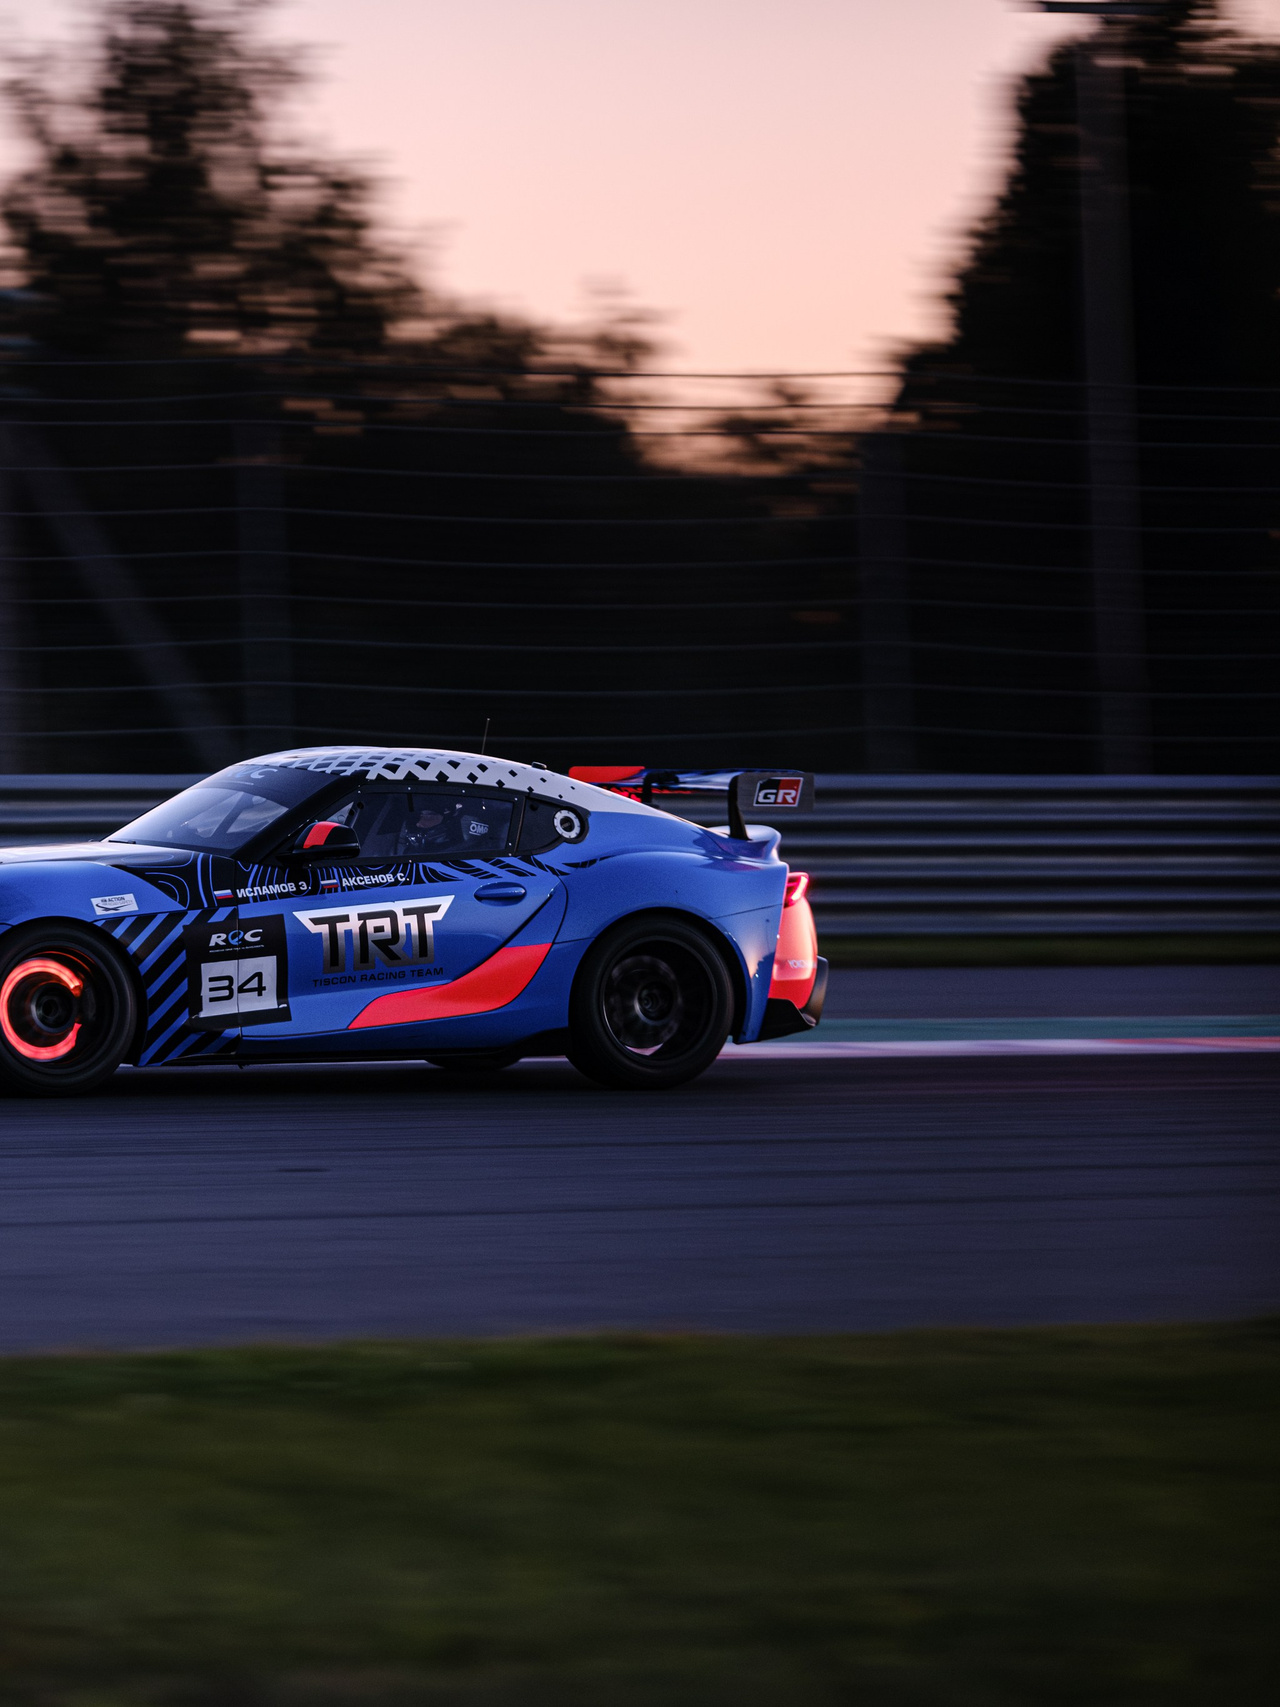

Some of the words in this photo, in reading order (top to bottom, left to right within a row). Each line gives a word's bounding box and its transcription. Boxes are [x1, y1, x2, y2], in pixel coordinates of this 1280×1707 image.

[757, 789, 797, 804] GR
[342, 875, 395, 887] АКСЕНОВ
[397, 872, 410, 882] С.
[236, 881, 297, 898] ИСЛАМОВ
[298, 881, 312, 891] Э.
[293, 895, 455, 974] TRT
[208, 971, 267, 1003] 34
[312, 975, 357, 988] TISCON
[360, 970, 406, 983] RACING
[410, 967, 444, 978] TEAM
